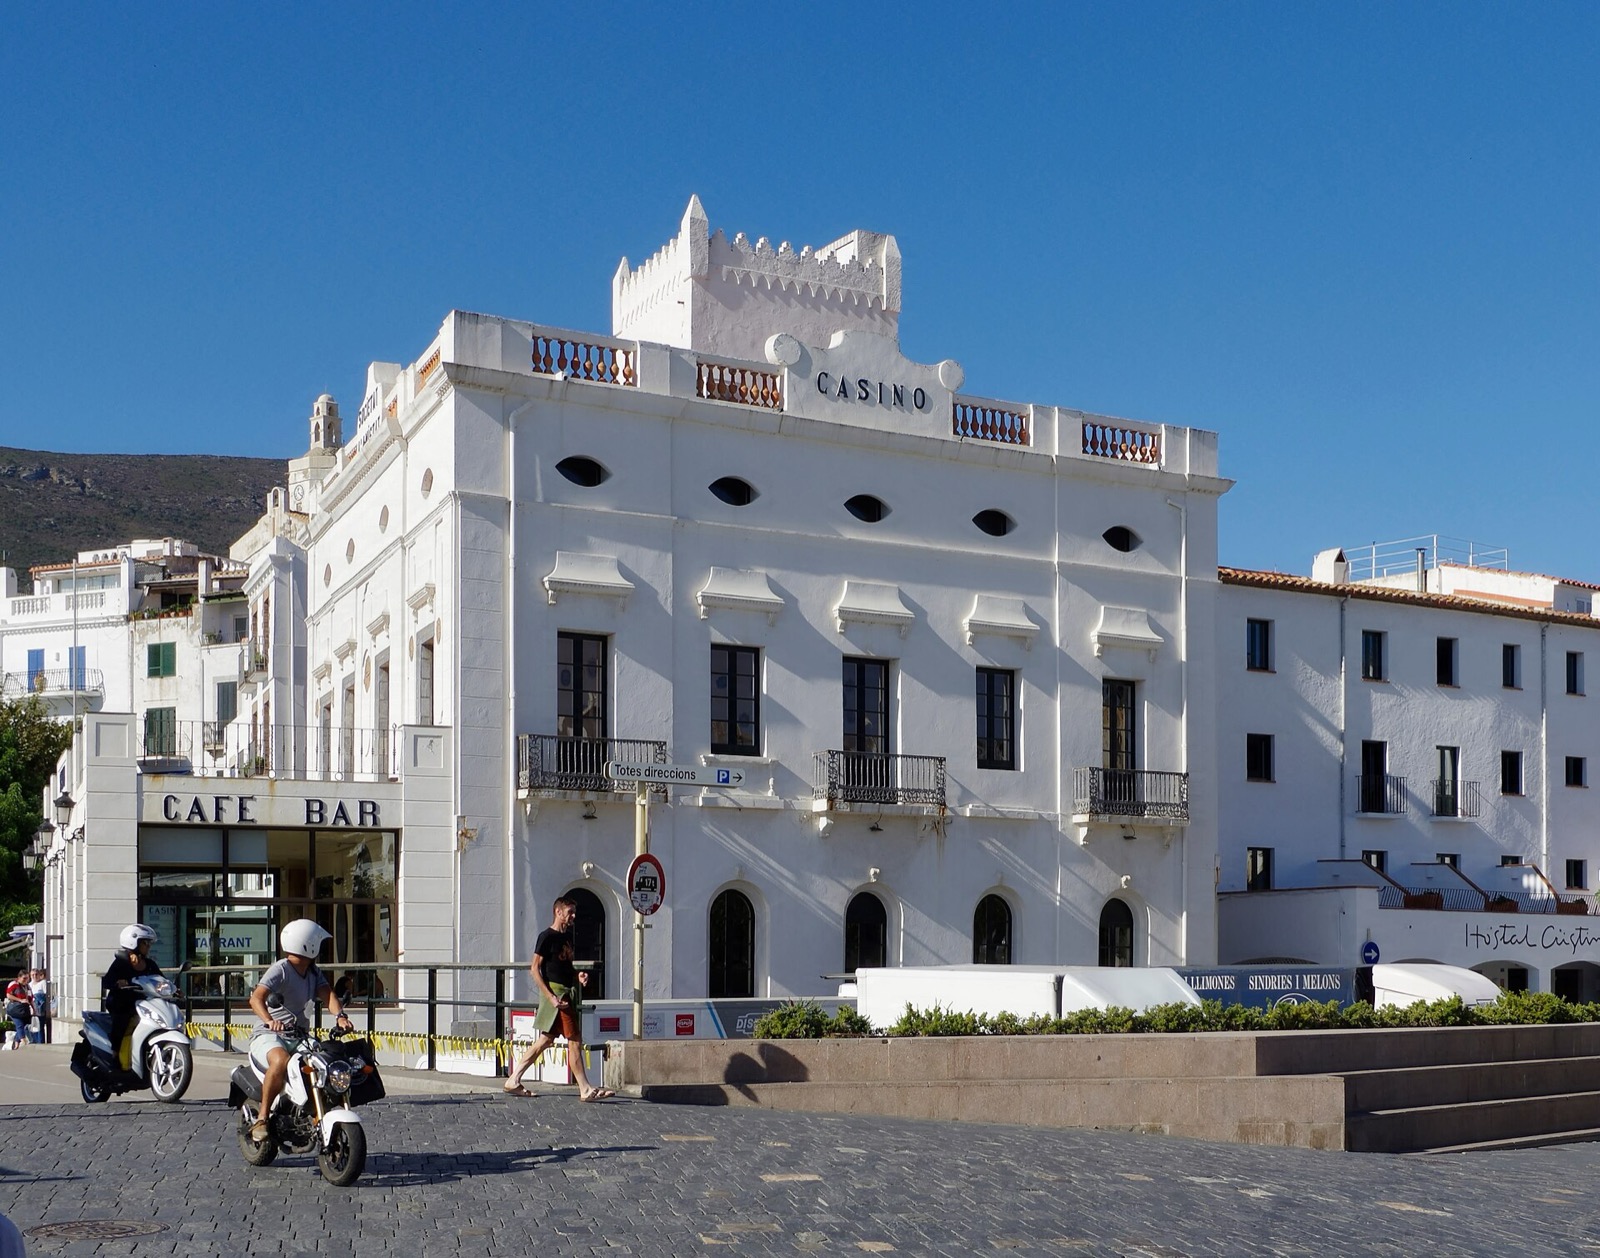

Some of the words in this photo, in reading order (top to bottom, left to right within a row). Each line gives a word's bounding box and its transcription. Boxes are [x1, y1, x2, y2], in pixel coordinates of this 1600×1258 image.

[816, 371, 926, 410] CASINO
[614, 764, 642, 777] Totes
[644, 766, 696, 780] direccions
[719, 770, 727, 782] P
[163, 794, 256, 823] CAFE
[304, 798, 379, 827] BAR
[149, 906, 176, 915] CASIN
[1465, 922, 1537, 950] Hostal
[1190, 975, 1235, 990] LLIMONES
[1249, 974, 1293, 990] SINDRIES
[1295, 974, 1300, 990] I
[1302, 974, 1341, 990] MELONS
